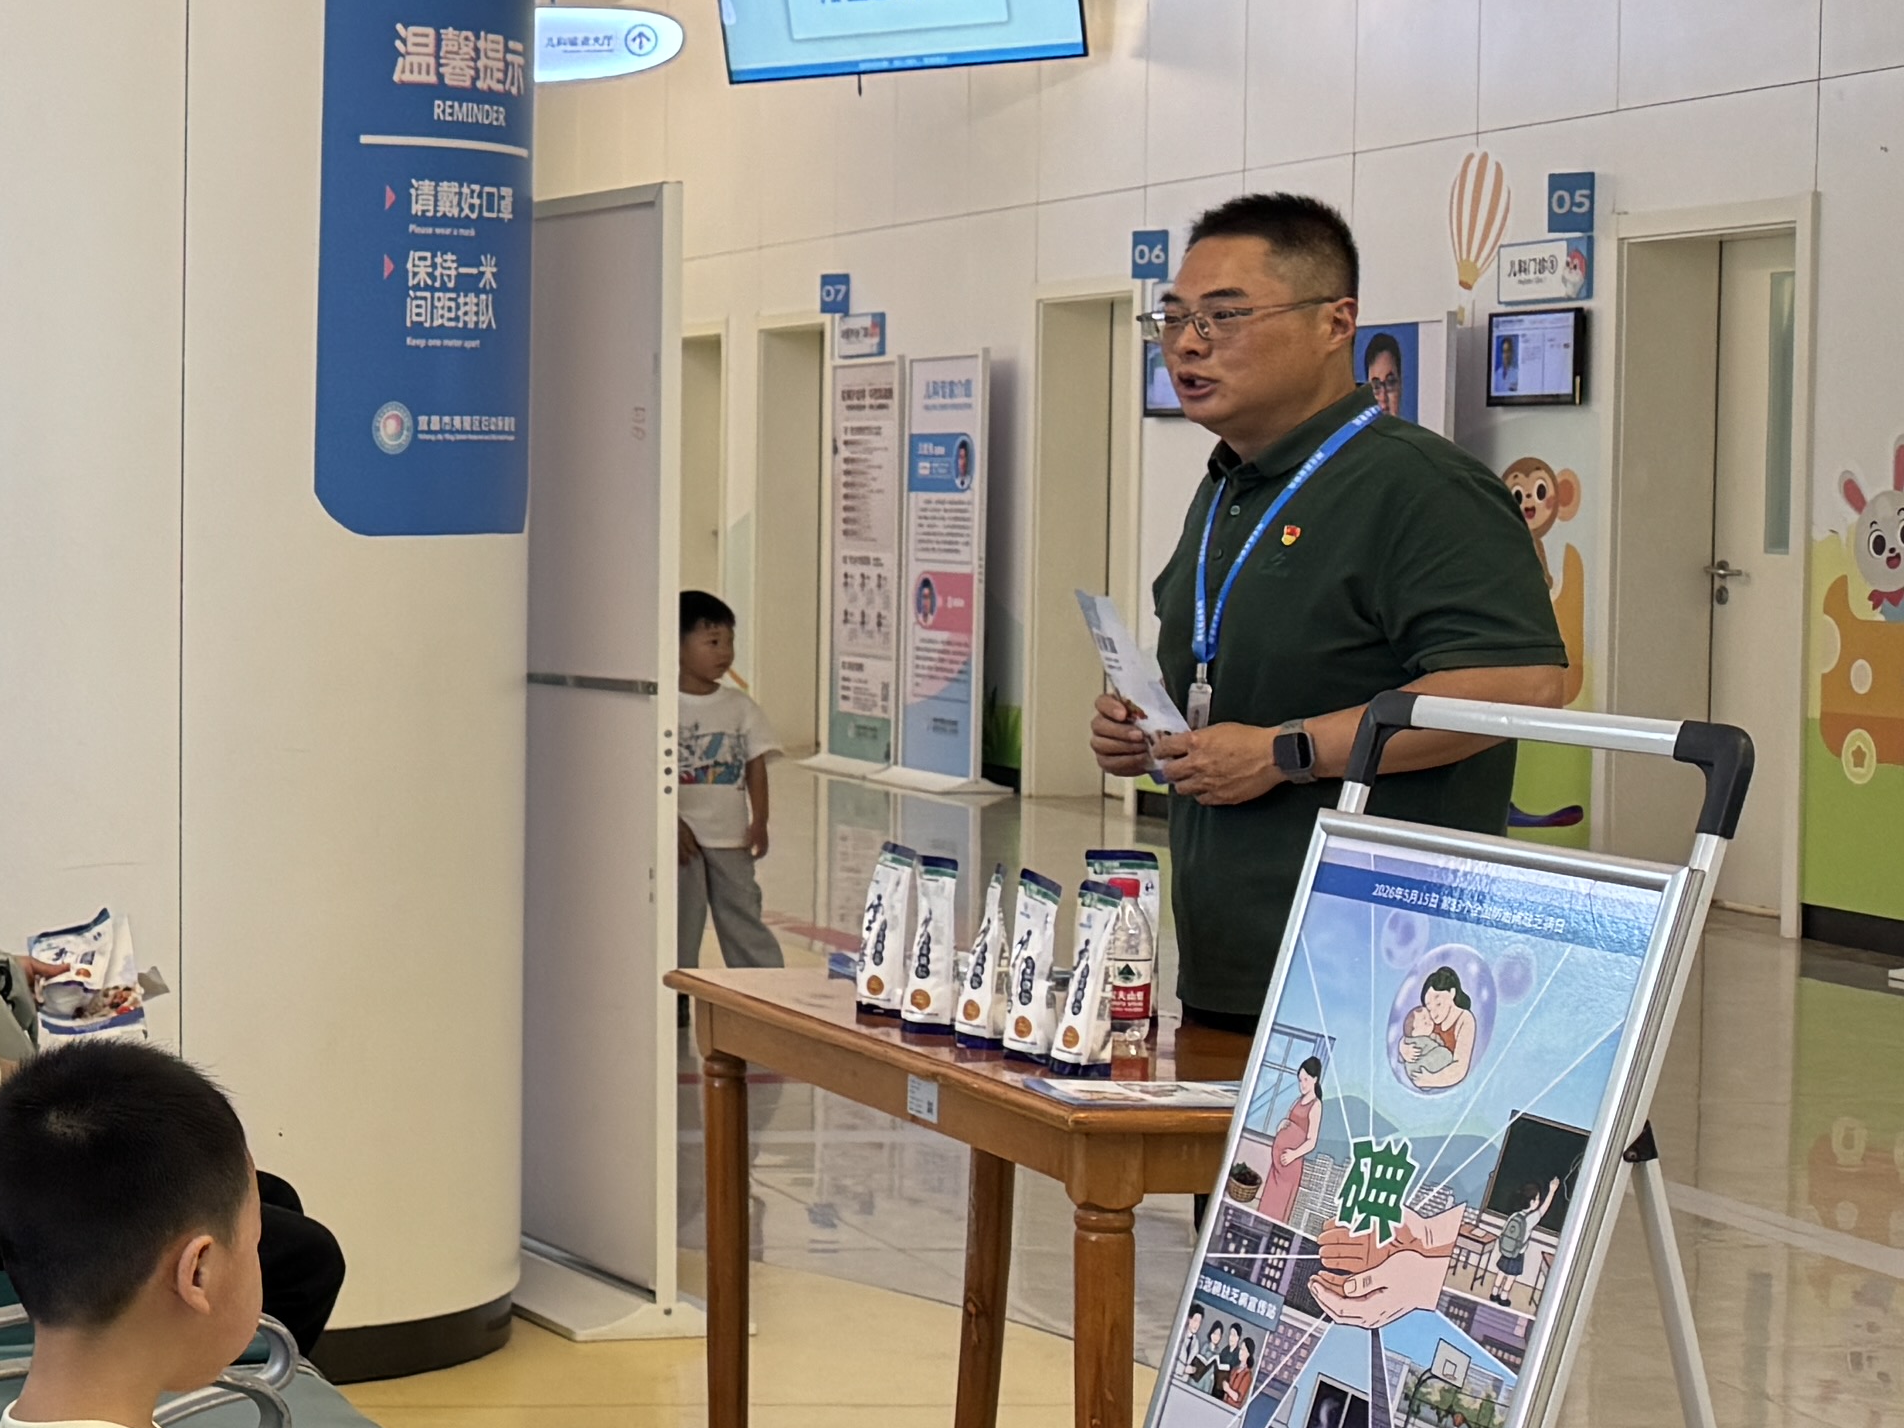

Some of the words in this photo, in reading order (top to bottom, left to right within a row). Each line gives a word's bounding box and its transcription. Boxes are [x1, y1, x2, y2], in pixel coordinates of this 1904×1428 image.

[392, 21, 525, 97] 温馨提示
[433, 99, 506, 128] REMINDER
[410, 178, 514, 222] 请戴好口罩
[1550, 187, 1591, 215] 05
[406, 250, 497, 290] 保持一米
[1133, 243, 1166, 265] 06
[406, 291, 496, 330] 间距排队
[822, 284, 847, 303] 07
[1339, 1140, 1416, 1243] 碘
